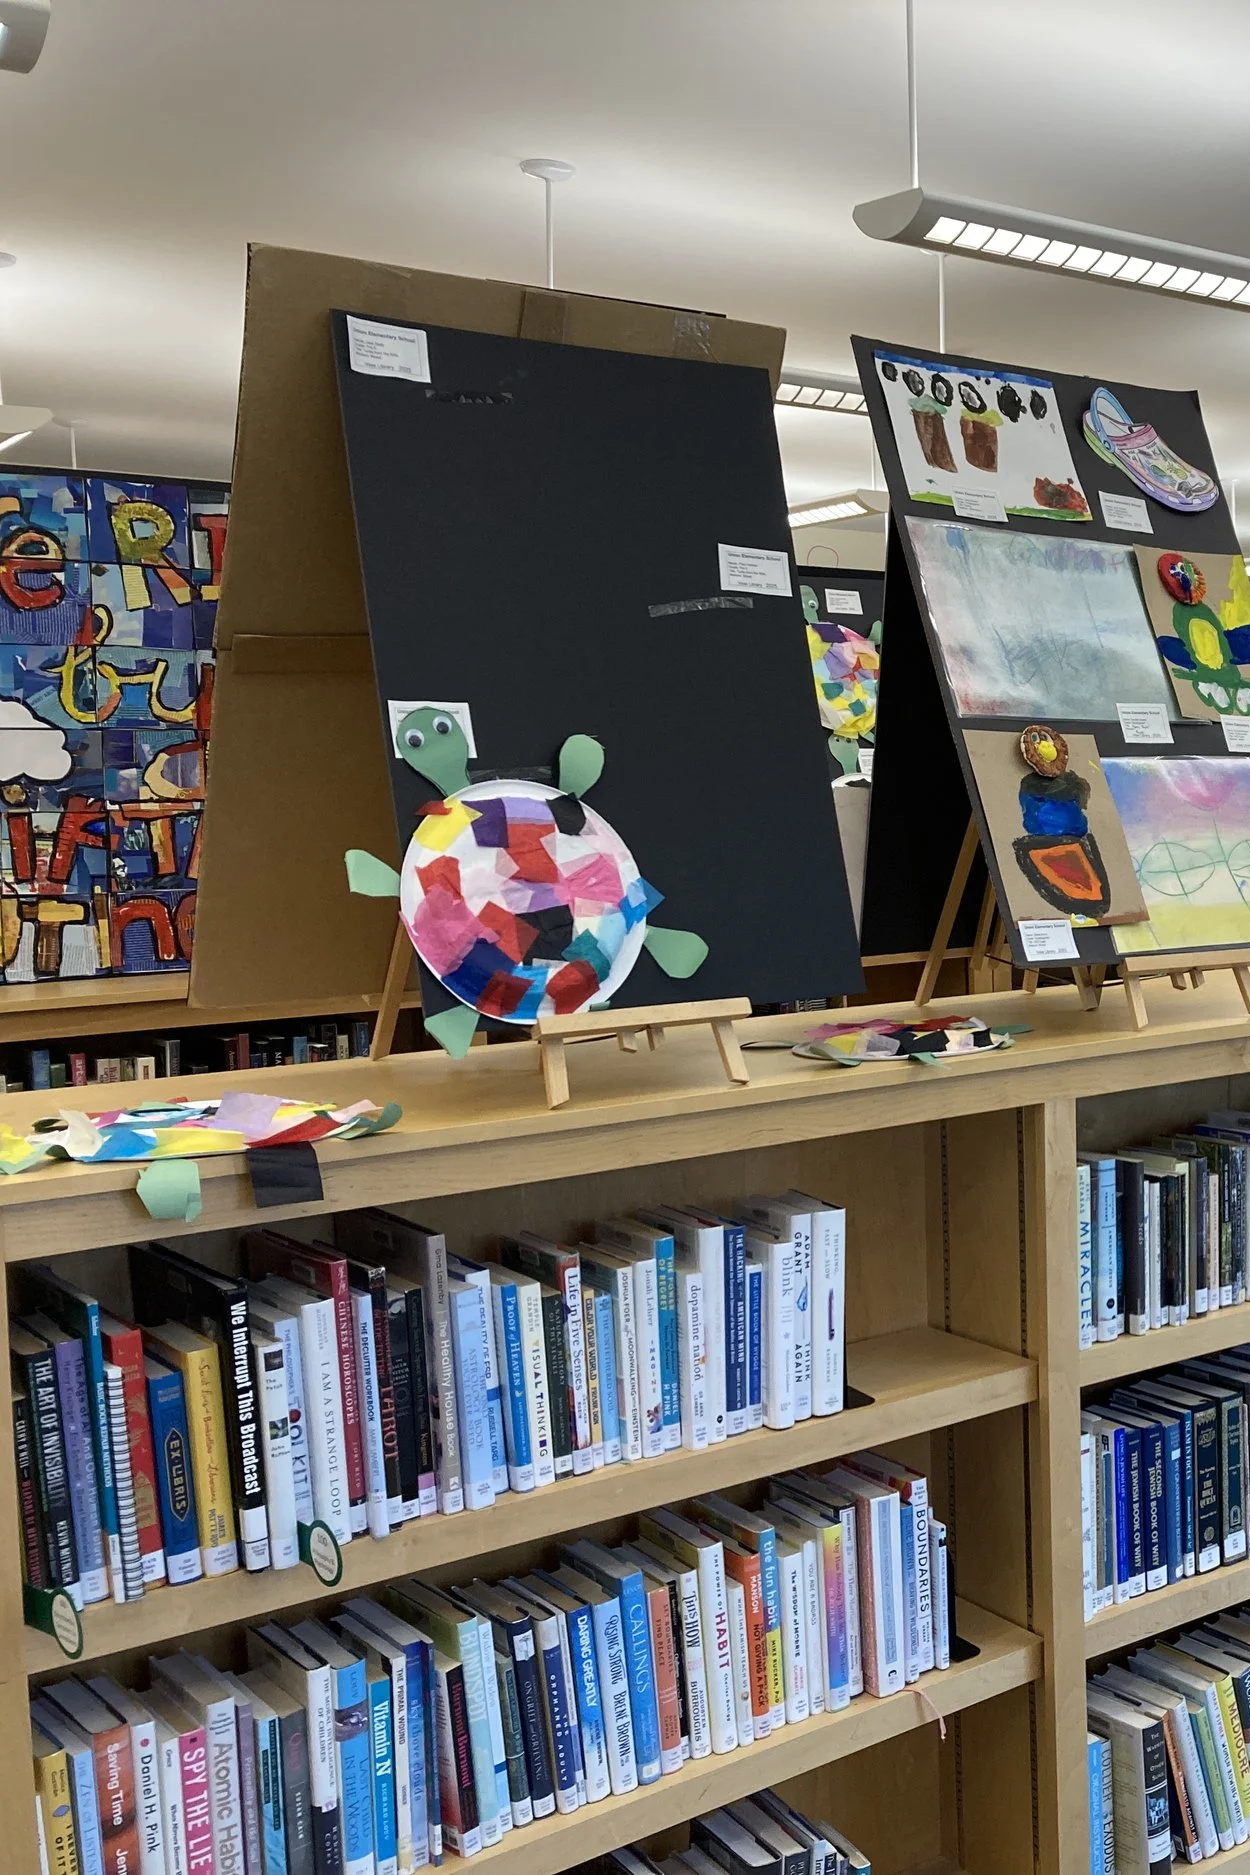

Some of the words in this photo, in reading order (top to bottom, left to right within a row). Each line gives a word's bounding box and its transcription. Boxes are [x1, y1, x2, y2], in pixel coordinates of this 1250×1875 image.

[368, 331, 396, 342] Elementary
[398, 334, 416, 344] School
[735, 1250, 744, 1282] HACKING
[794, 1232, 802, 1273] GRANT
[567, 1274, 579, 1300] Life
[620, 1272, 629, 1300] JOSHUA
[781, 1257, 793, 1295] blink
[1078, 1221, 1092, 1330] MIRACLES
[230, 1300, 246, 1323] We
[338, 1301, 348, 1348] CHINESE
[569, 1304, 579, 1316] in
[622, 1303, 631, 1321] FOER
[687, 1285, 701, 1339] dopamine
[736, 1301, 744, 1339] AMERICAN
[359, 1321, 367, 1334] THE
[570, 1320, 582, 1347] Five
[34, 1358, 53, 1383] THE
[229, 1326, 252, 1386] Interrupt
[360, 1337, 371, 1374] DECLUTTER
[572, 1350, 584, 1390] Senses
[691, 1345, 704, 1380] nation
[94, 1381, 105, 1402] BASIC
[320, 1372, 331, 1388] AM
[342, 1354, 353, 1424] HOROSCOPES
[468, 1347, 481, 1413] ASTROLOGY
[37, 1386, 56, 1410] ART
[96, 1404, 107, 1424] BOOK
[237, 1390, 253, 1419] This
[364, 1377, 376, 1420] WORKBOOK
[670, 1382, 678, 1414] DANIEL
[41, 1413, 57, 1428] OF
[380, 1383, 399, 1459] TAROT
[474, 1419, 484, 1448] BOOK
[99, 1426, 109, 1449] REPAIR
[323, 1411, 338, 1472] STRANGE
[43, 1431, 67, 1507] INVISIBILITY
[101, 1451, 113, 1487] METHODS
[238, 1422, 261, 1493] Broadcast
[1130, 1470, 1138, 1501] JEWISH
[1148, 1467, 1157, 1498] JEWISH
[1155, 1460, 1163, 1496] SECOND
[330, 1478, 342, 1514] LOOP
[1149, 1502, 1158, 1527] BOOK
[56, 1520, 69, 1544] KEVIN
[1133, 1532, 1140, 1544] OF
[1151, 1531, 1158, 1543] OF
[59, 1547, 73, 1582] MITNICK
[762, 1540, 773, 1561] the
[914, 1509, 931, 1611] BOUNDARIES
[1133, 1545, 1141, 1566] WHY
[1151, 1545, 1159, 1565] WHY
[764, 1566, 775, 1587] fun
[681, 1591, 699, 1620] THIS
[749, 1575, 760, 1613] MANSON
[765, 1592, 778, 1624] habit
[574, 1615, 595, 1658] DARING
[602, 1616, 622, 1649] RISING
[626, 1603, 652, 1692] CALLINGS
[683, 1619, 701, 1648] HOW
[713, 1611, 731, 1668] HABIT
[456, 1630, 490, 1721] BLINDSPOT
[578, 1659, 600, 1707] GREATLY
[608, 1651, 625, 1684] STRONG
[317, 1707, 324, 1716] OF
[324, 1698, 332, 1725] MORAL
[407, 1698, 420, 1719] sky
[612, 1690, 630, 1724] BRENÉ
[688, 1680, 703, 1741] BURROUGHS
[318, 1720, 326, 1762] CHILDREN
[370, 1700, 394, 1756] Vitamin
[410, 1725, 422, 1758] above
[548, 1675, 563, 1736] ORPHANED
[556, 1744, 568, 1781] ADULT
[615, 1723, 634, 1756] BROWN
[1226, 1702, 1249, 1777] MEDIOCRE
[103, 1743, 123, 1788] Saving
[182, 1747, 208, 1784] SPY
[325, 1729, 335, 1786] INTELLIGENCE
[343, 1755, 354, 1768] IN
[358, 1759, 370, 1788] LAST
[375, 1761, 390, 1775] N
[139, 1755, 156, 1799] Daniel
[345, 1776, 357, 1798] THE
[412, 1762, 424, 1800] clouds
[1099, 1749, 1112, 1802] COLLIER
[109, 1790, 125, 1825] Time
[144, 1803, 158, 1819] H.
[187, 1790, 210, 1828] THE
[360, 1793, 373, 1836] CHILD
[144, 1823, 160, 1852] Pink
[345, 1802, 362, 1852] WOODS
[191, 1834, 212, 1865] LIE
[1101, 1823, 1115, 1872] EXODUS
